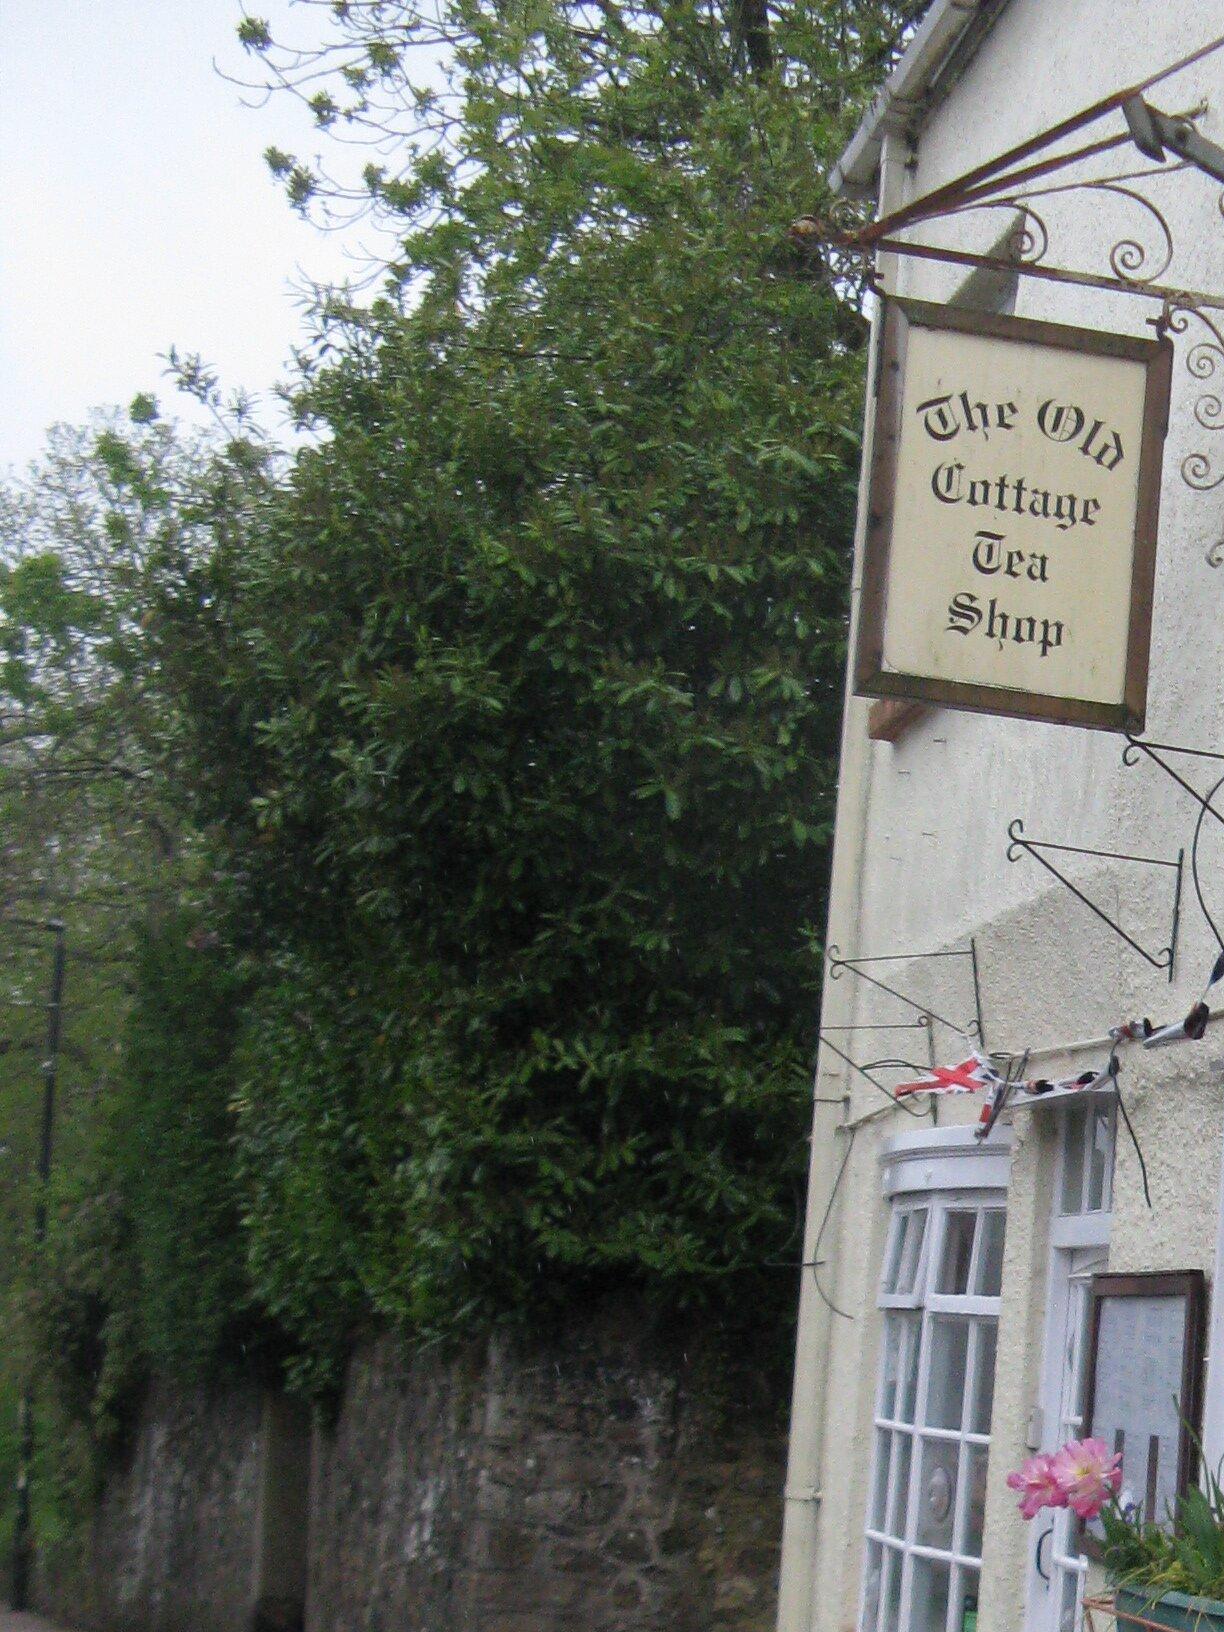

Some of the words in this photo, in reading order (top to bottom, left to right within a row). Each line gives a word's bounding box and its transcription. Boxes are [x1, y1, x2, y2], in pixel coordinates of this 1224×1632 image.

[916, 392, 1019, 441] The
[1036, 399, 1125, 472] Old
[931, 460, 1101, 531] Cottage
[972, 530, 1050, 583] Tea
[945, 592, 1065, 657] Shop
